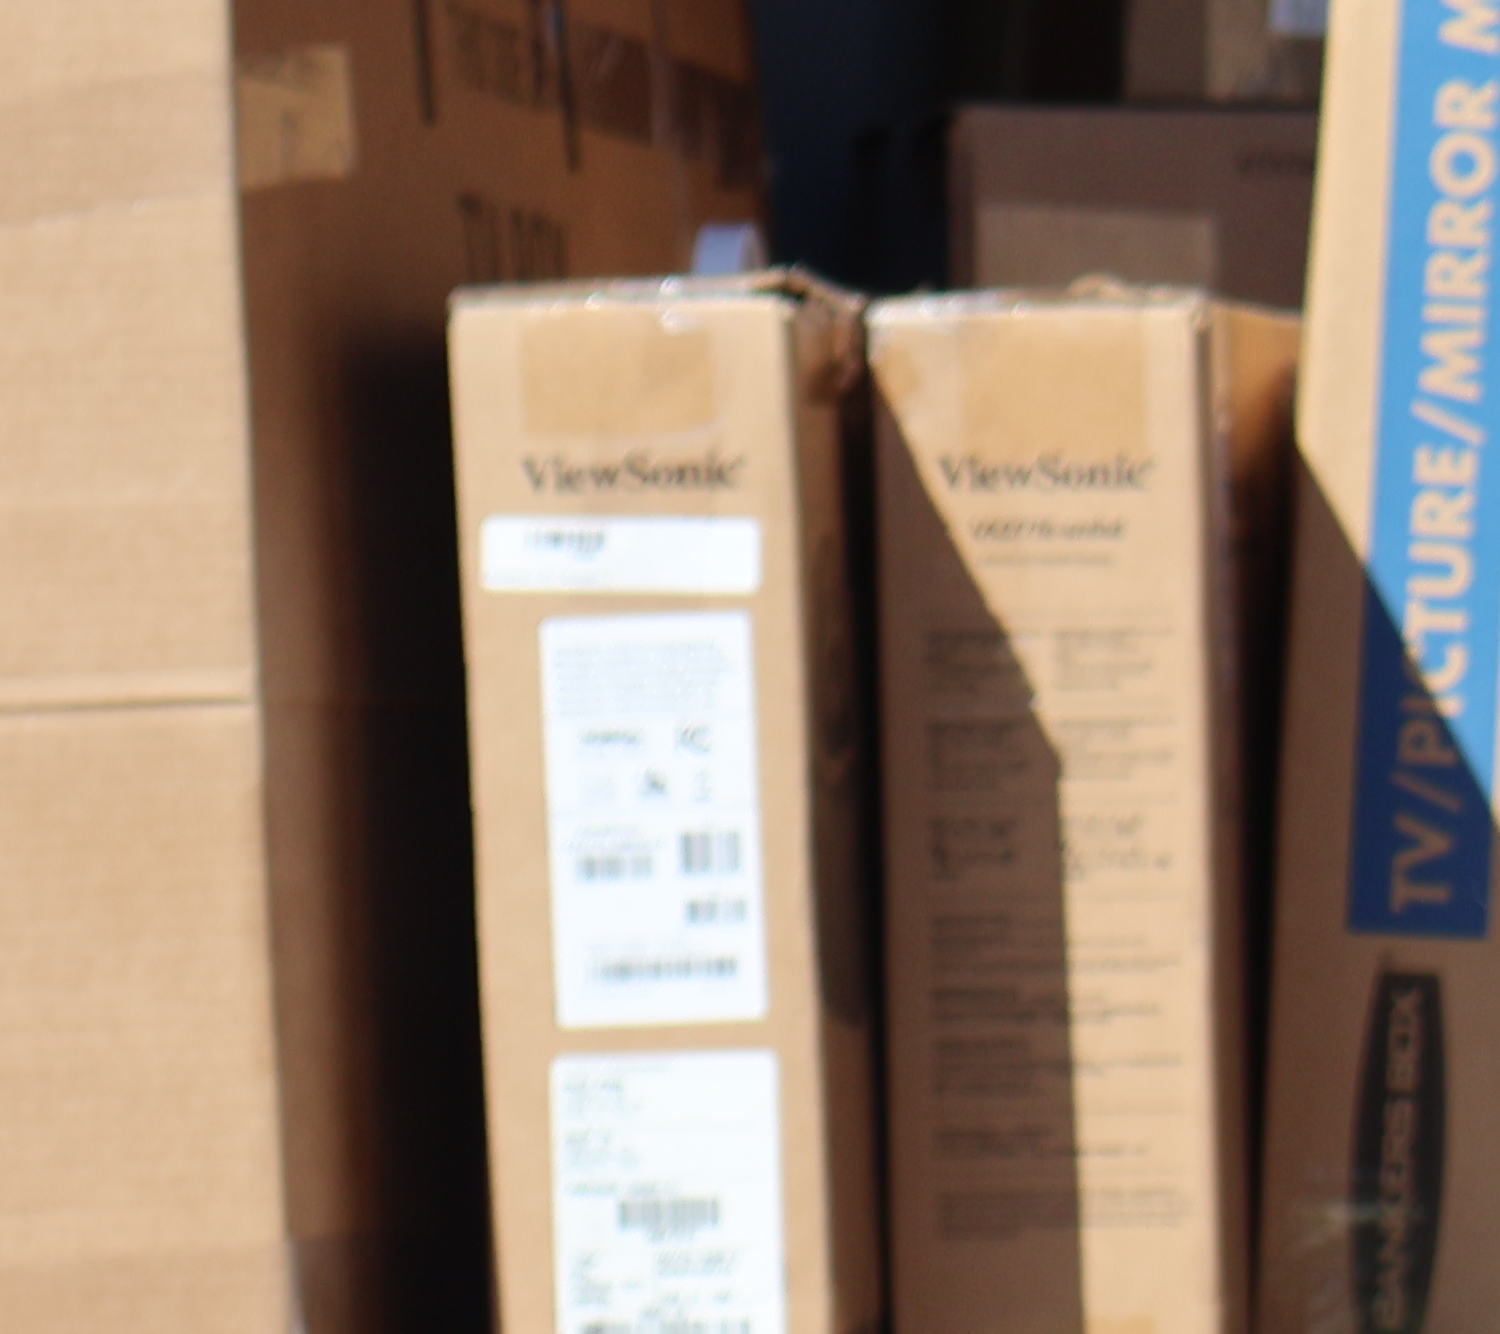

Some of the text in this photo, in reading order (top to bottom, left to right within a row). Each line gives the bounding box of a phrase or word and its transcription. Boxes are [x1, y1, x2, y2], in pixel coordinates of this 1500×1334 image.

[521, 452, 748, 494] ViewSonic
[938, 453, 1160, 493] ViewSonic
[1389, 80, 1500, 910] TV/PICTURE/MIRROR
